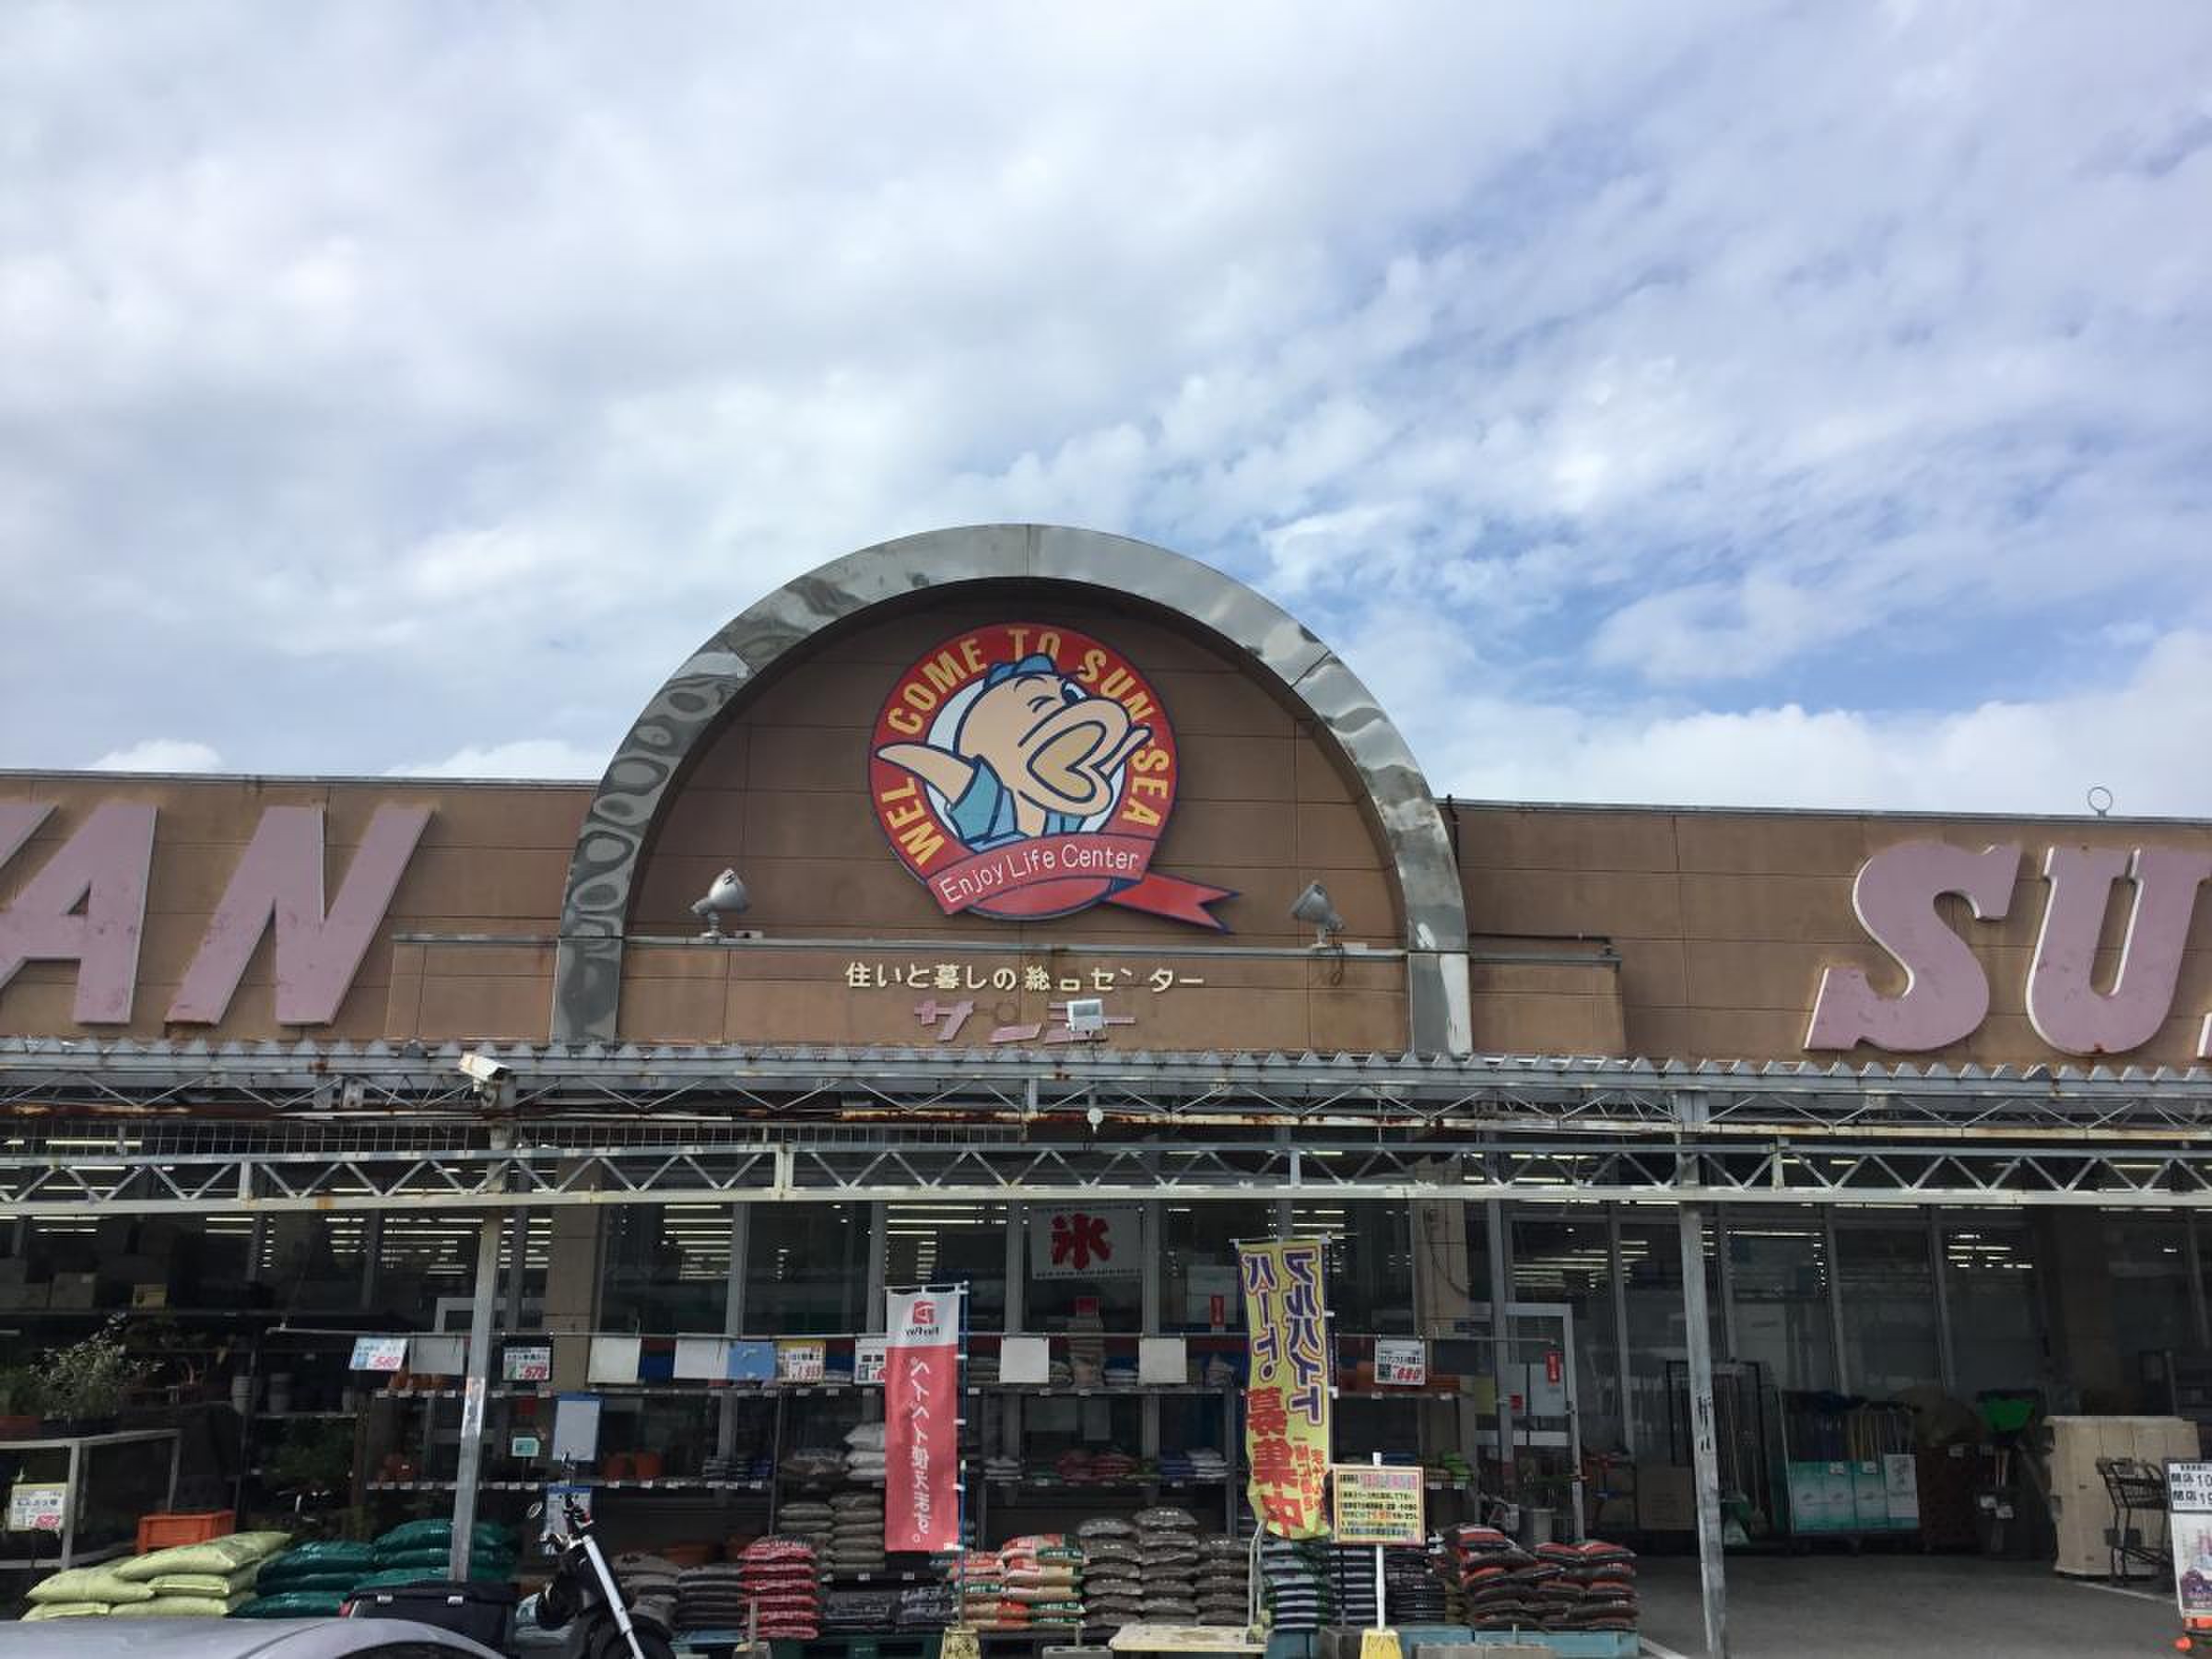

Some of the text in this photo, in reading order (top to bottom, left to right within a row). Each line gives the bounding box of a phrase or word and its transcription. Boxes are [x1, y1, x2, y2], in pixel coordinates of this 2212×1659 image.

[888, 639, 989, 735] COME
[1006, 629, 1061, 661] TO
[0, 800, 436, 1027] AN
[938, 843, 1139, 903] Enjoy Life Center
[1804, 839, 2212, 1058] SU
[1052, 1212, 1112, 1268] 氷
